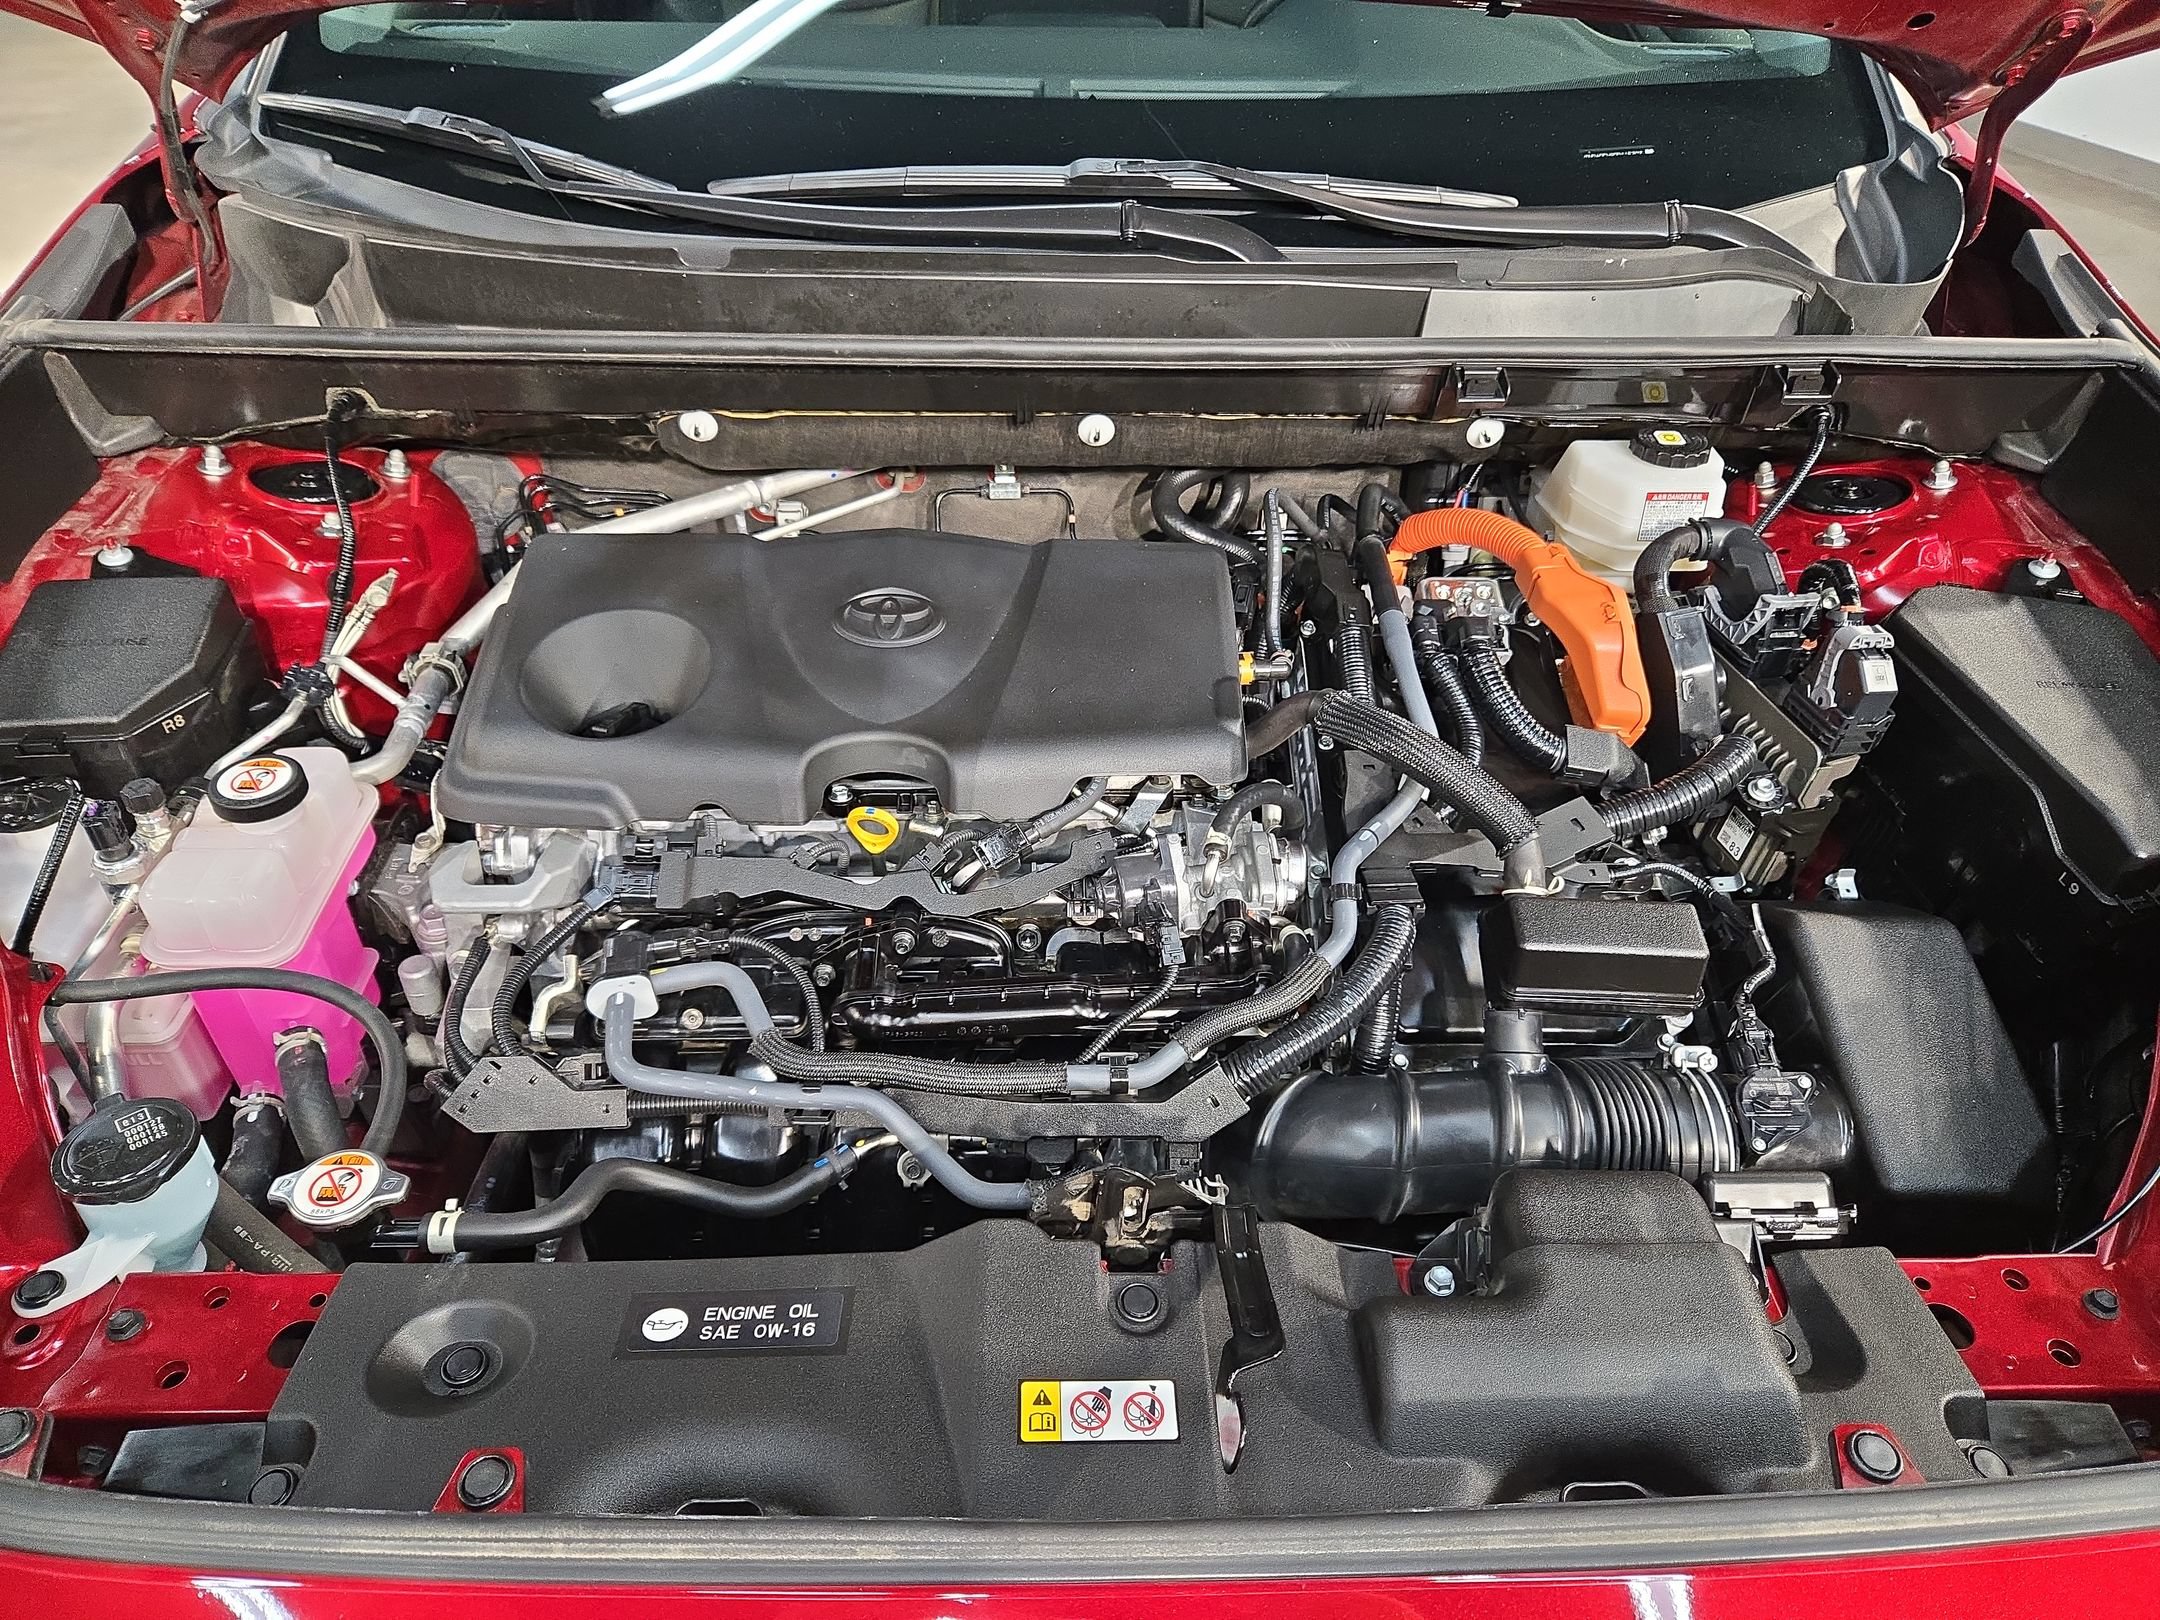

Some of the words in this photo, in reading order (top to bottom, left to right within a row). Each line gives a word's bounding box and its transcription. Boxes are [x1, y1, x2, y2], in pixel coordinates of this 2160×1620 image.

[162, 714, 186, 734] R8
[122, 1113, 145, 1127] e13
[124, 1116, 163, 1137] 000127
[126, 1123, 166, 1145] 000128
[129, 1131, 168, 1151] 000145
[703, 1305, 776, 1321] ENGINE
[788, 1303, 819, 1318] OIL
[699, 1324, 741, 1340] SAE
[753, 1322, 816, 1338] 0W-16
